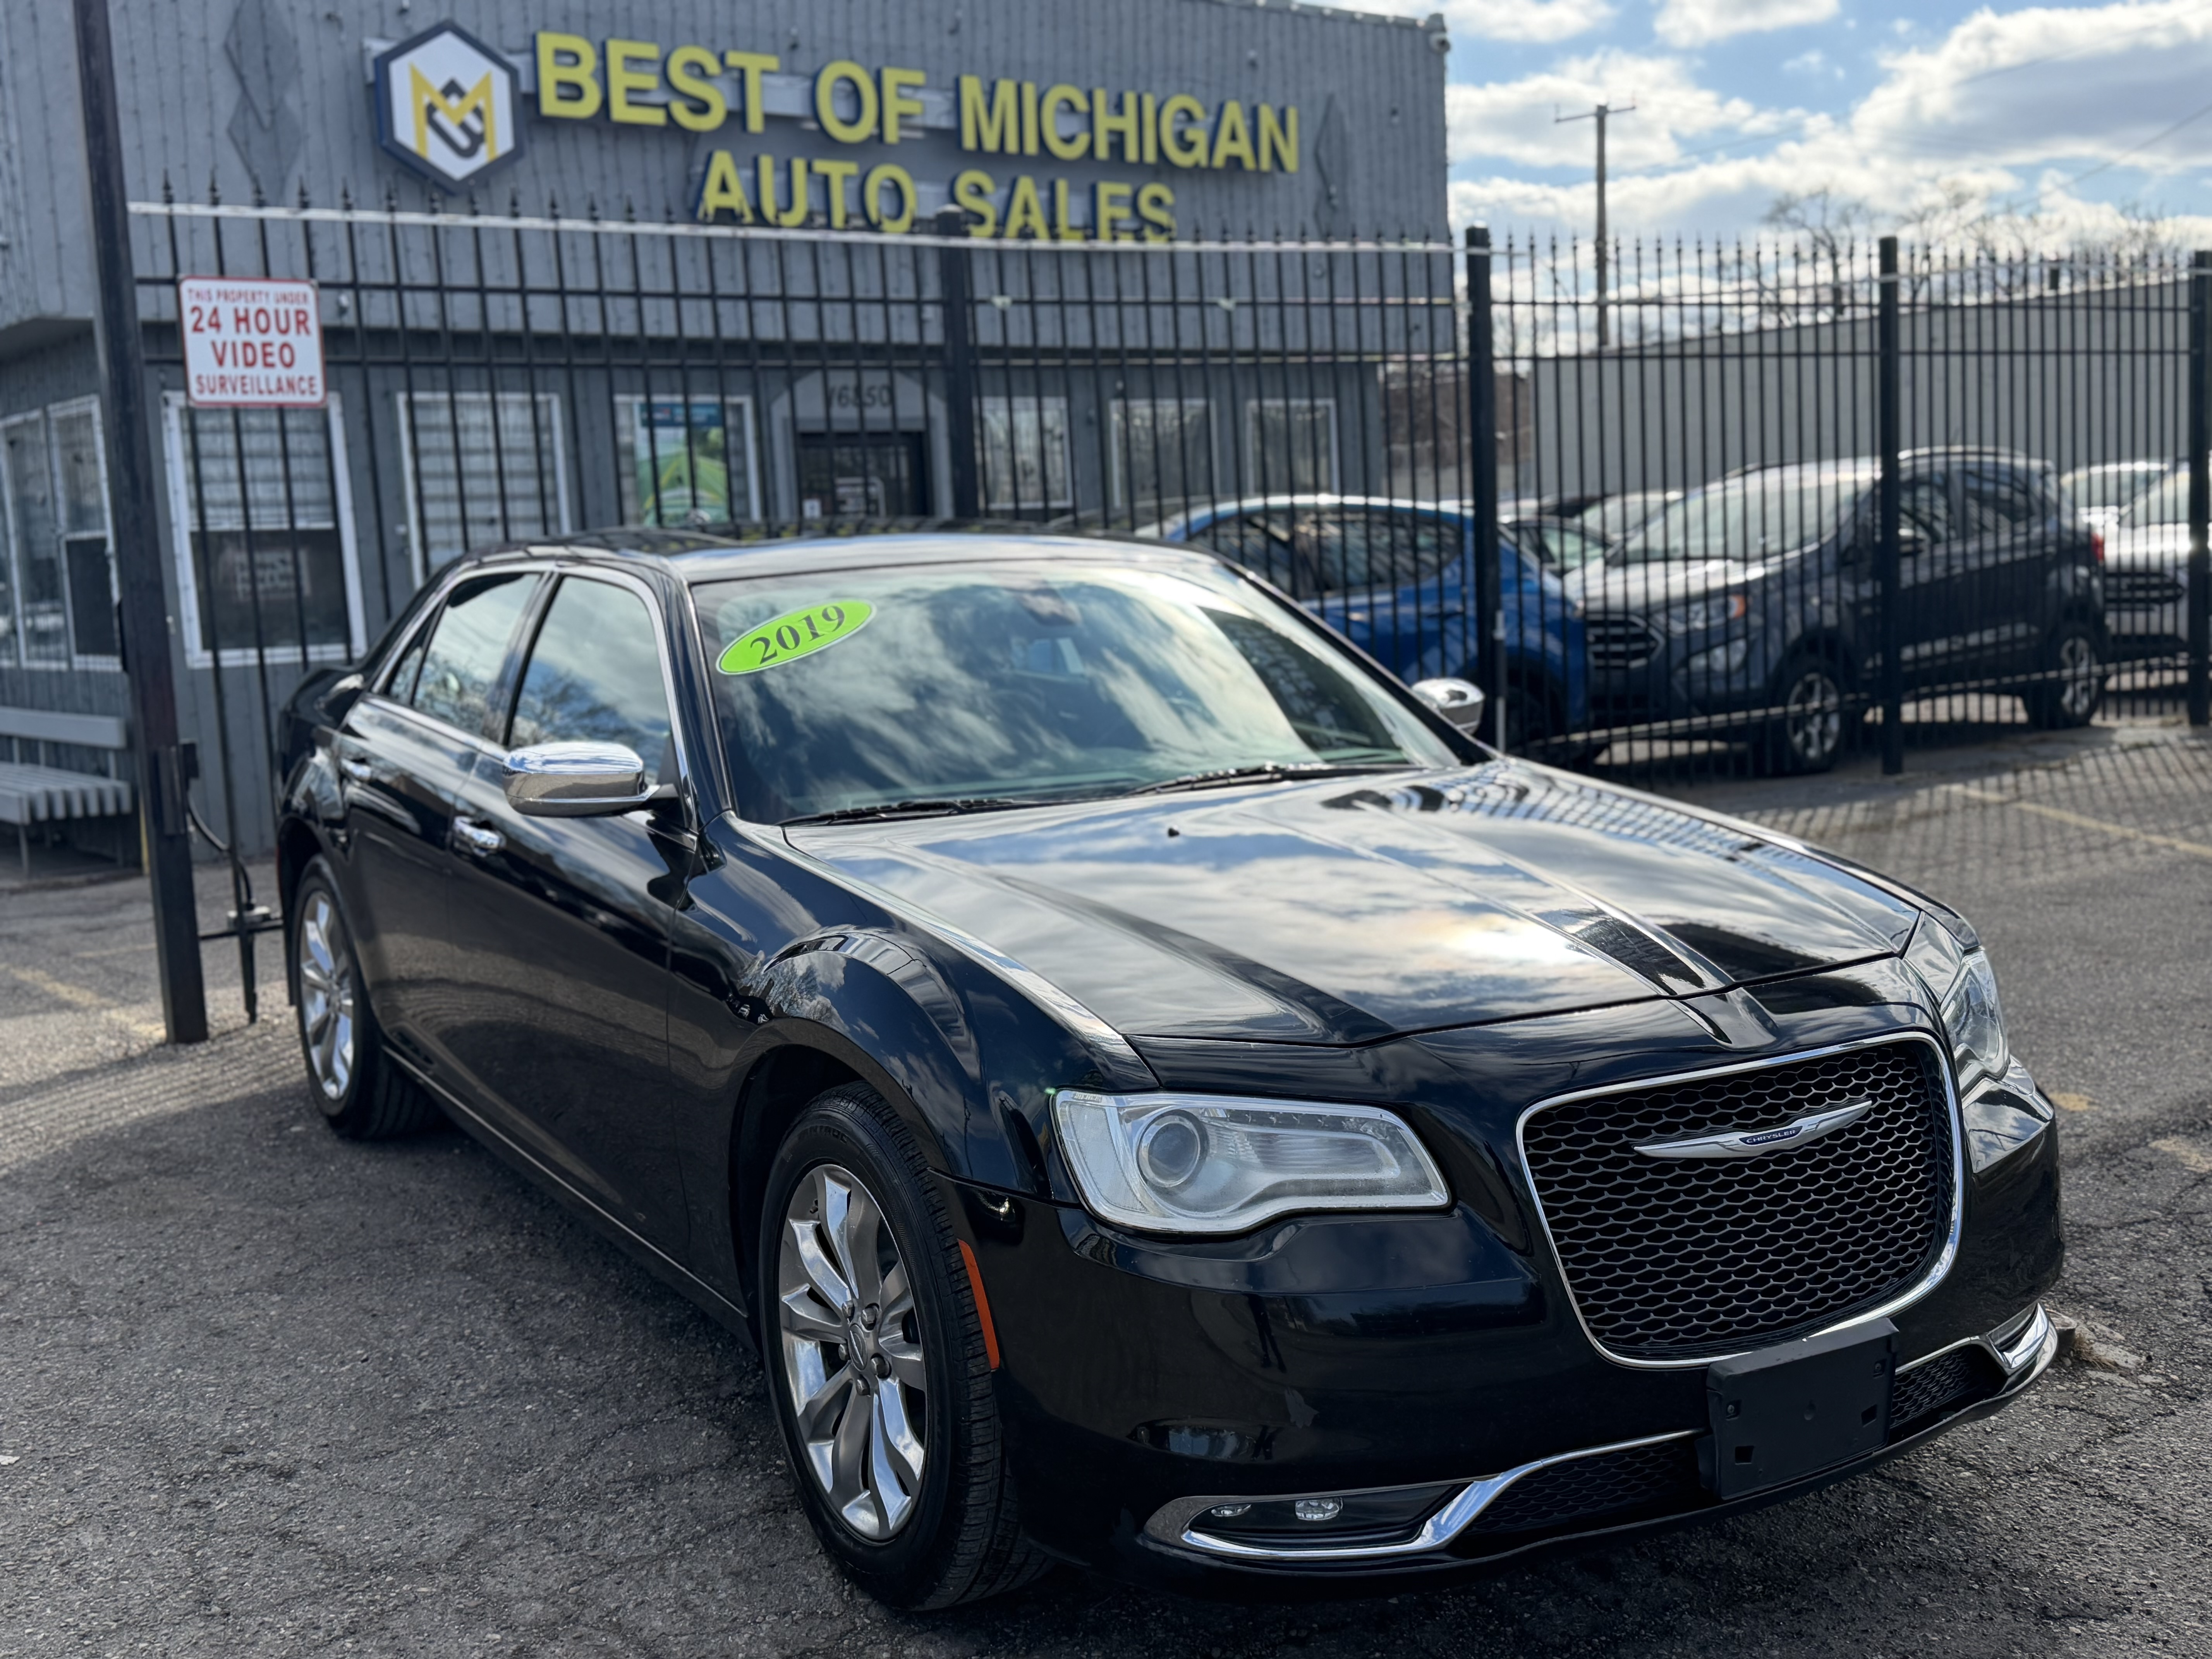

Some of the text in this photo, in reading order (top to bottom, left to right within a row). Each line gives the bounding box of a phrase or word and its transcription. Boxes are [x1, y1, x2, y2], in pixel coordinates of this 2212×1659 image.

[536, 31, 1299, 173] BEST OF MICHIGAN
[699, 150, 1177, 242] AUTO SALES
[188, 289, 309, 305] THIS PROPERTY UNDER
[190, 305, 311, 336] 24 HOUR
[211, 340, 295, 369] VIDEO
[196, 374, 317, 396] SURVEILLANCE
[750, 606, 845, 665] 2019
[1746, 1130, 1796, 1143] CHRYSLER
